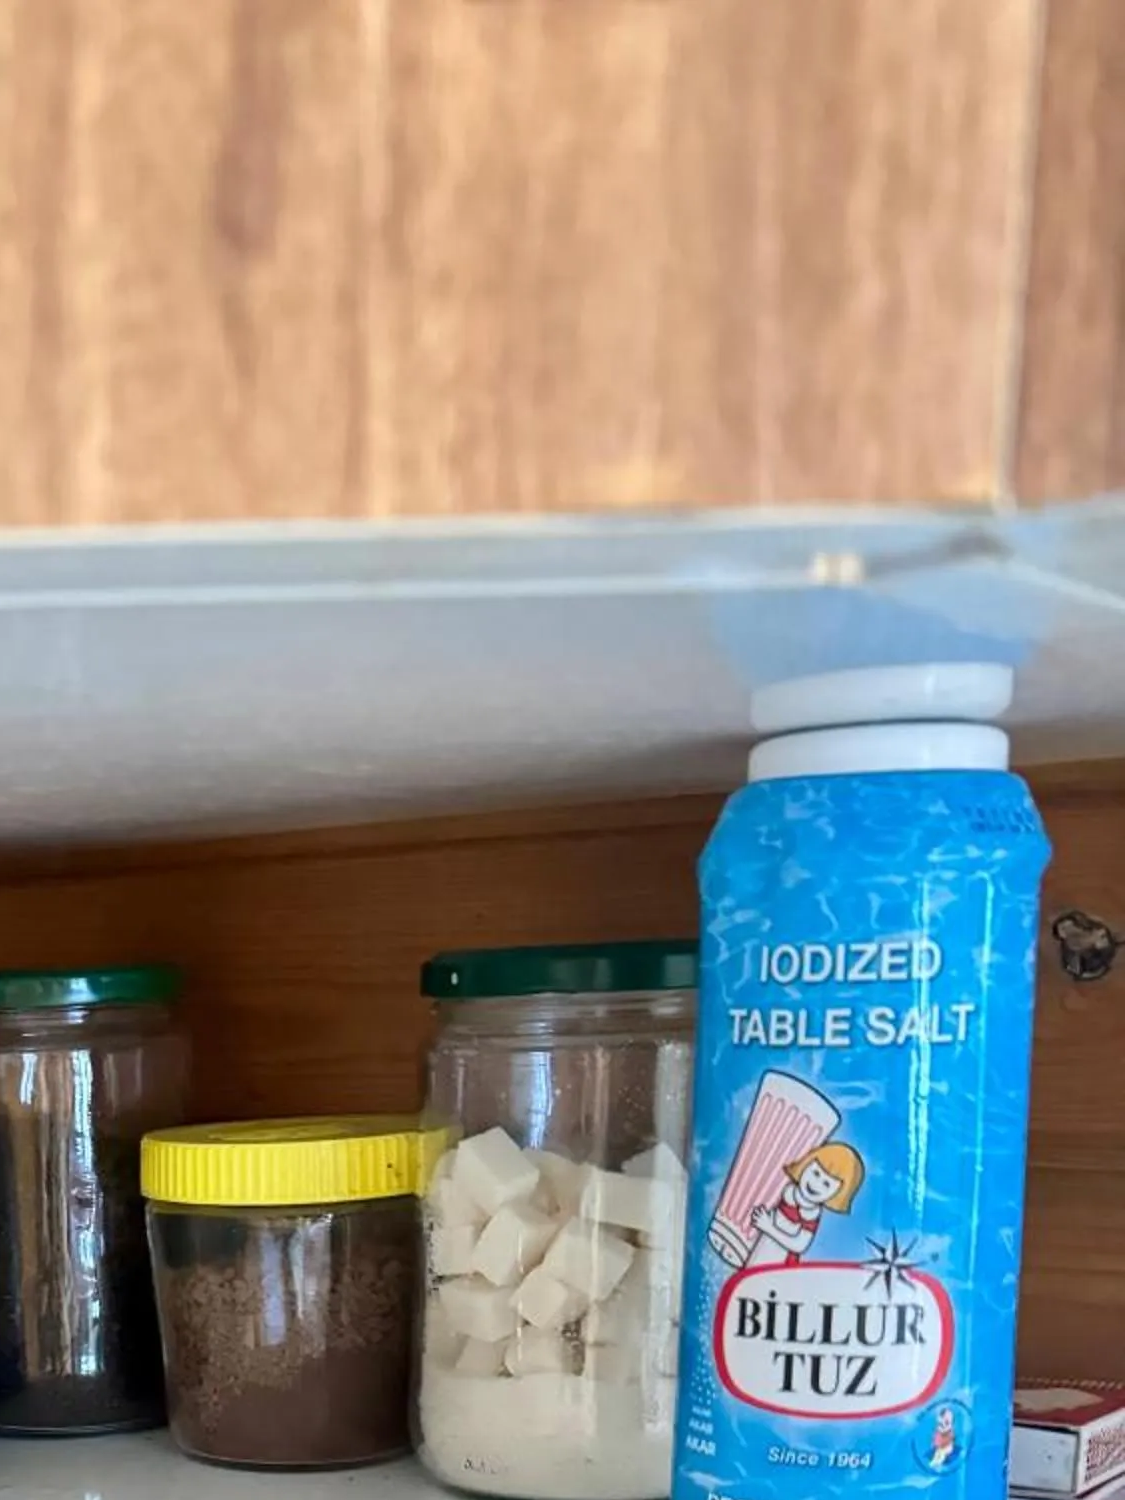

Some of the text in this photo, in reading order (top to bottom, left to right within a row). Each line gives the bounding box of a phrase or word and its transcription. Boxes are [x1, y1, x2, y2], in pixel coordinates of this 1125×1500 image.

[759, 940, 942, 983] IODIZED
[730, 1003, 975, 1047] TABLE SALT
[774, 1350, 879, 1397] TUZ
[767, 1445, 872, 1469] Since 1964
